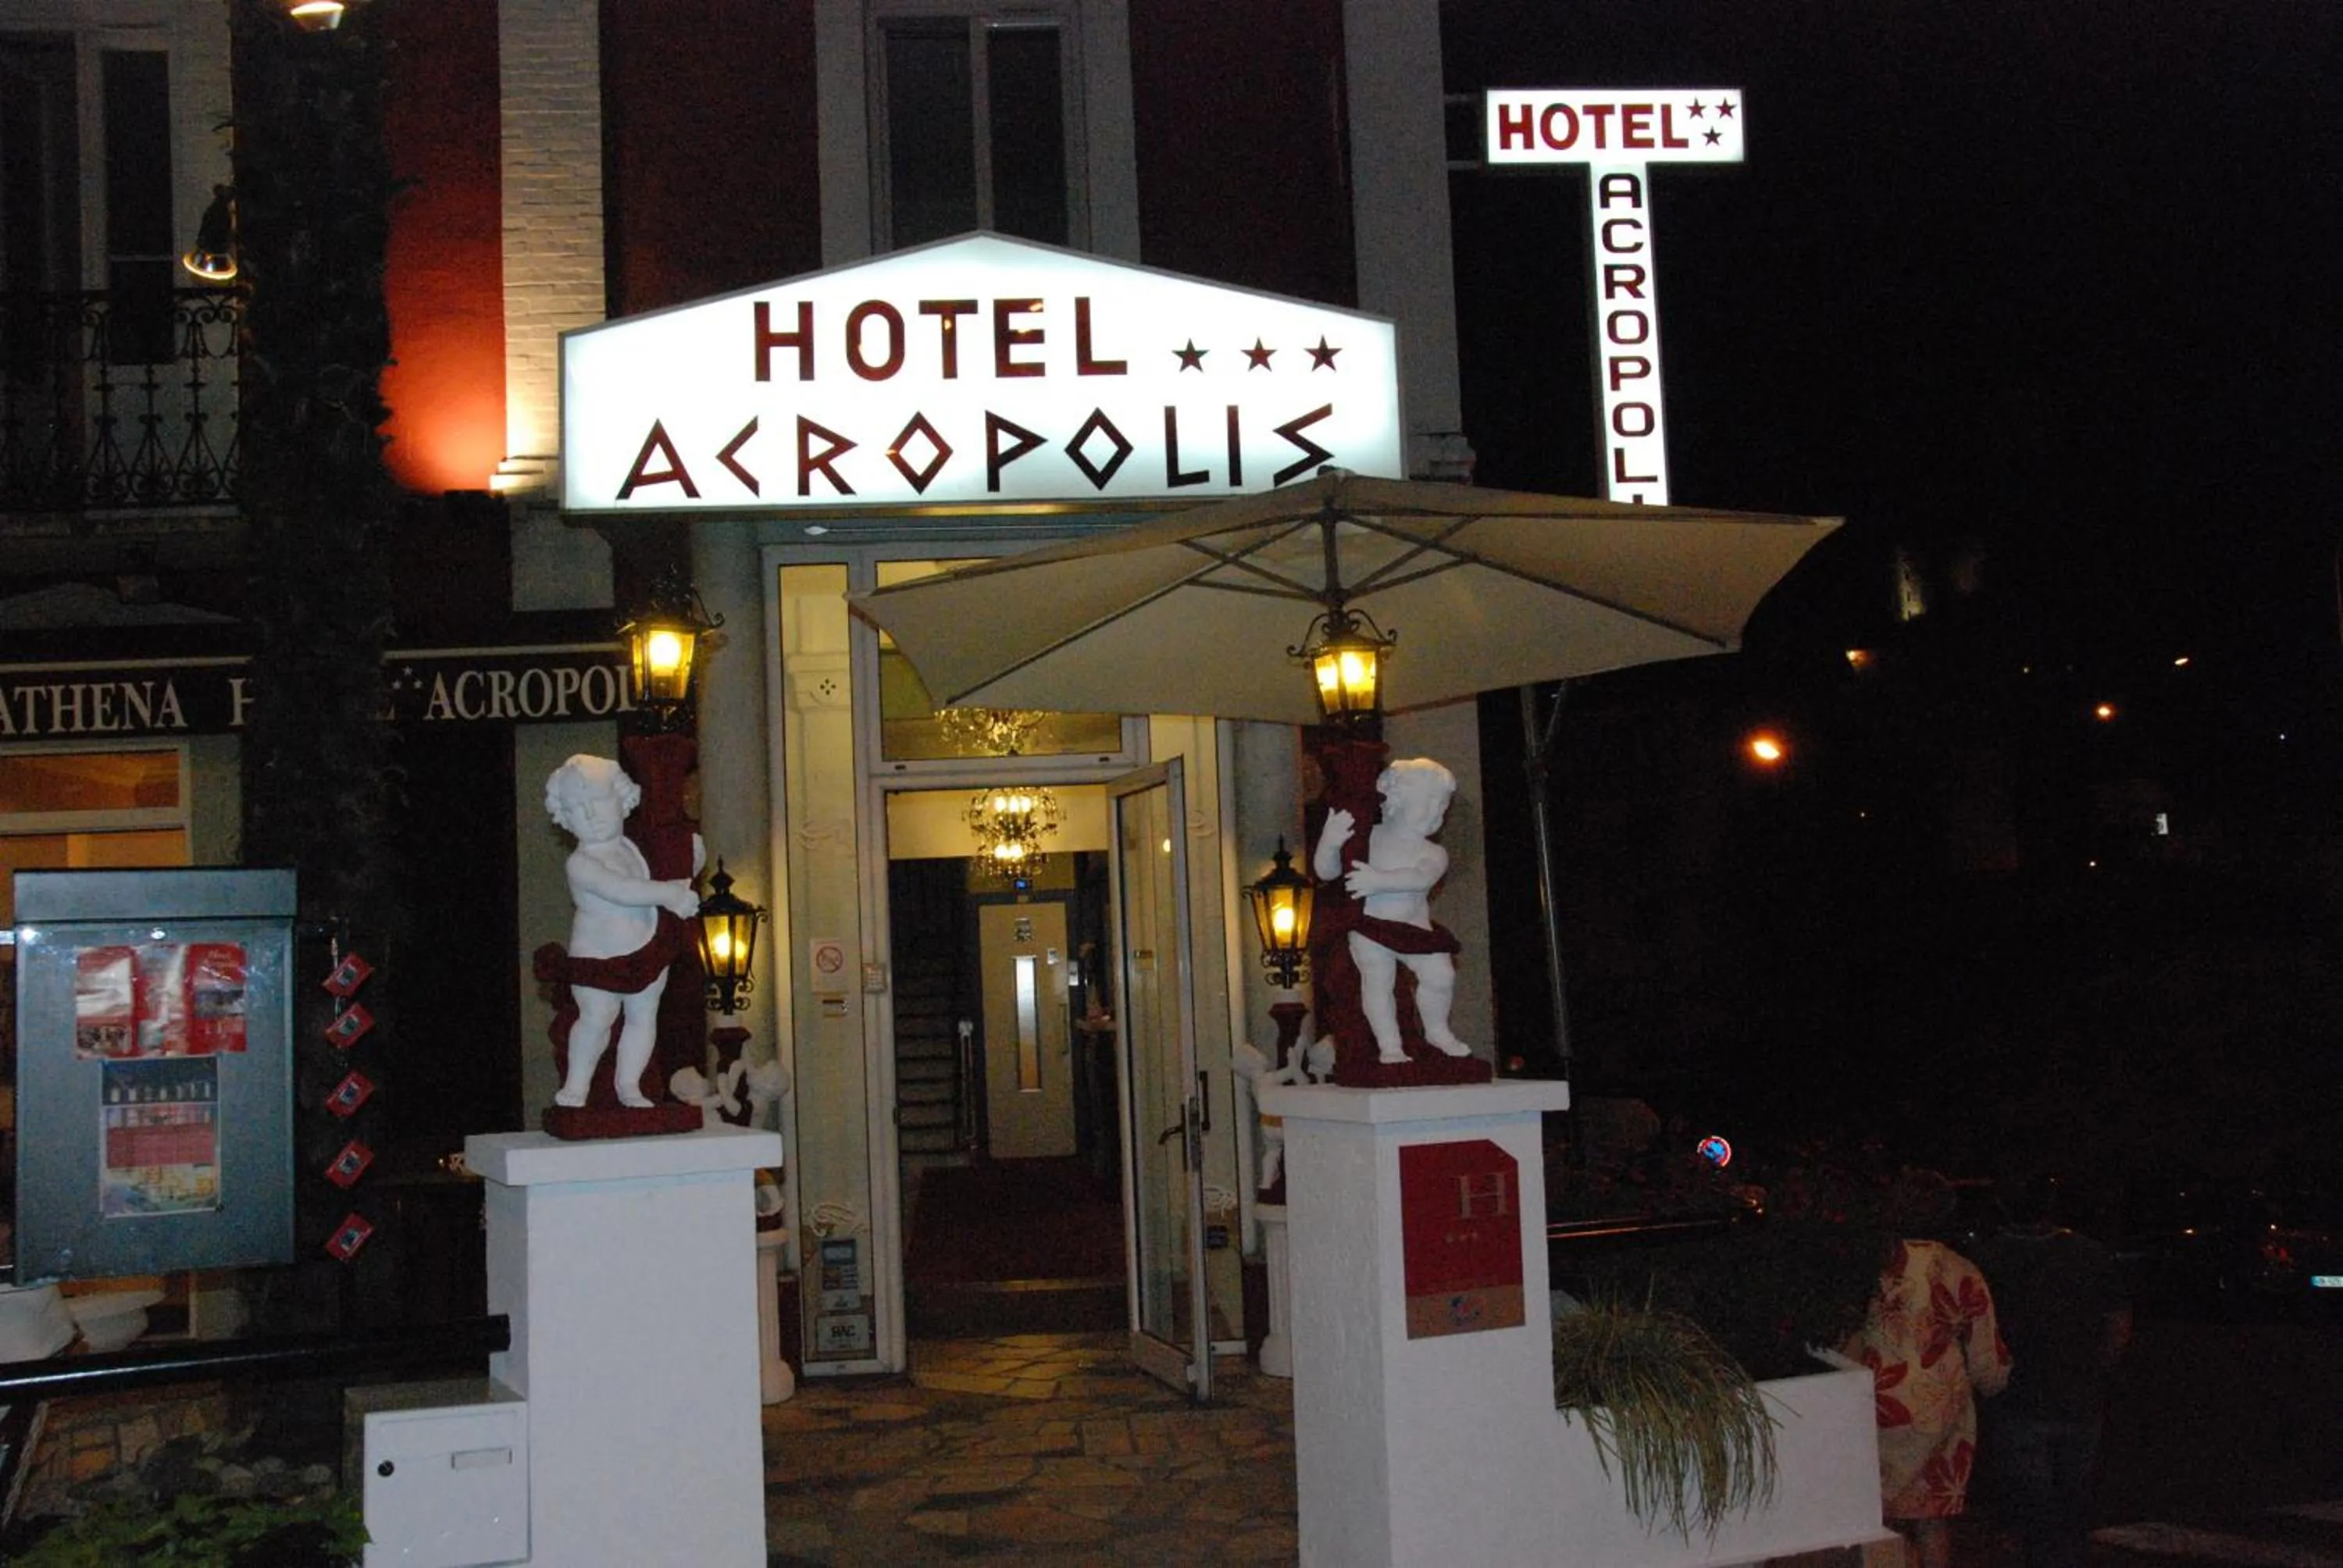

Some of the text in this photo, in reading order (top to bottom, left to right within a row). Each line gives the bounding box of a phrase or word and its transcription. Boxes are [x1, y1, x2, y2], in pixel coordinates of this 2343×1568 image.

[1498, 103, 1689, 150] HOTEL
[754, 296, 1128, 382] HOTEL
[615, 401, 1335, 500] ACROPOLIS
